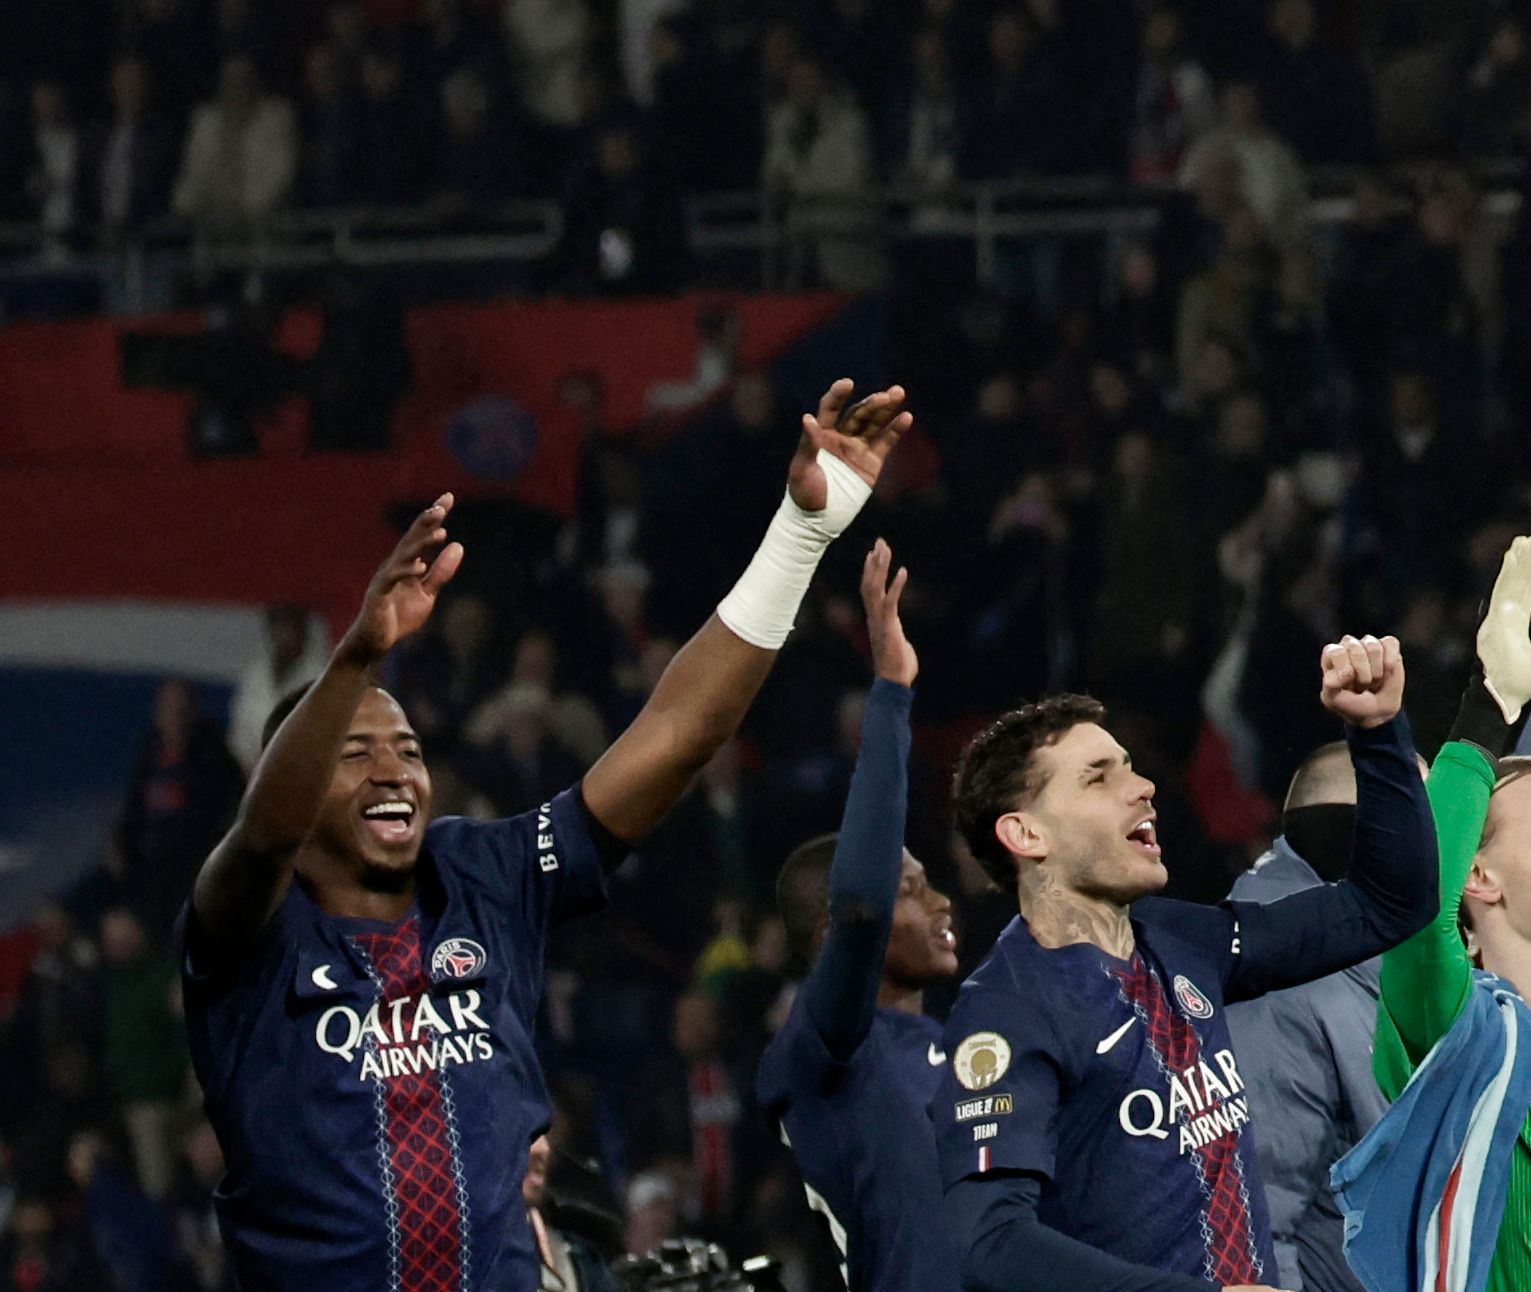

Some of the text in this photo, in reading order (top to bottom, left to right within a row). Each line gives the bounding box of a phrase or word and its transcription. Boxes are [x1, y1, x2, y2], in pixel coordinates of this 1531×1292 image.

[315, 989, 490, 1062] QATAR
[360, 1032, 493, 1081] AIRWAYS
[956, 1101, 984, 1120] LIGUE
[1119, 1049, 1245, 1140] QATAR
